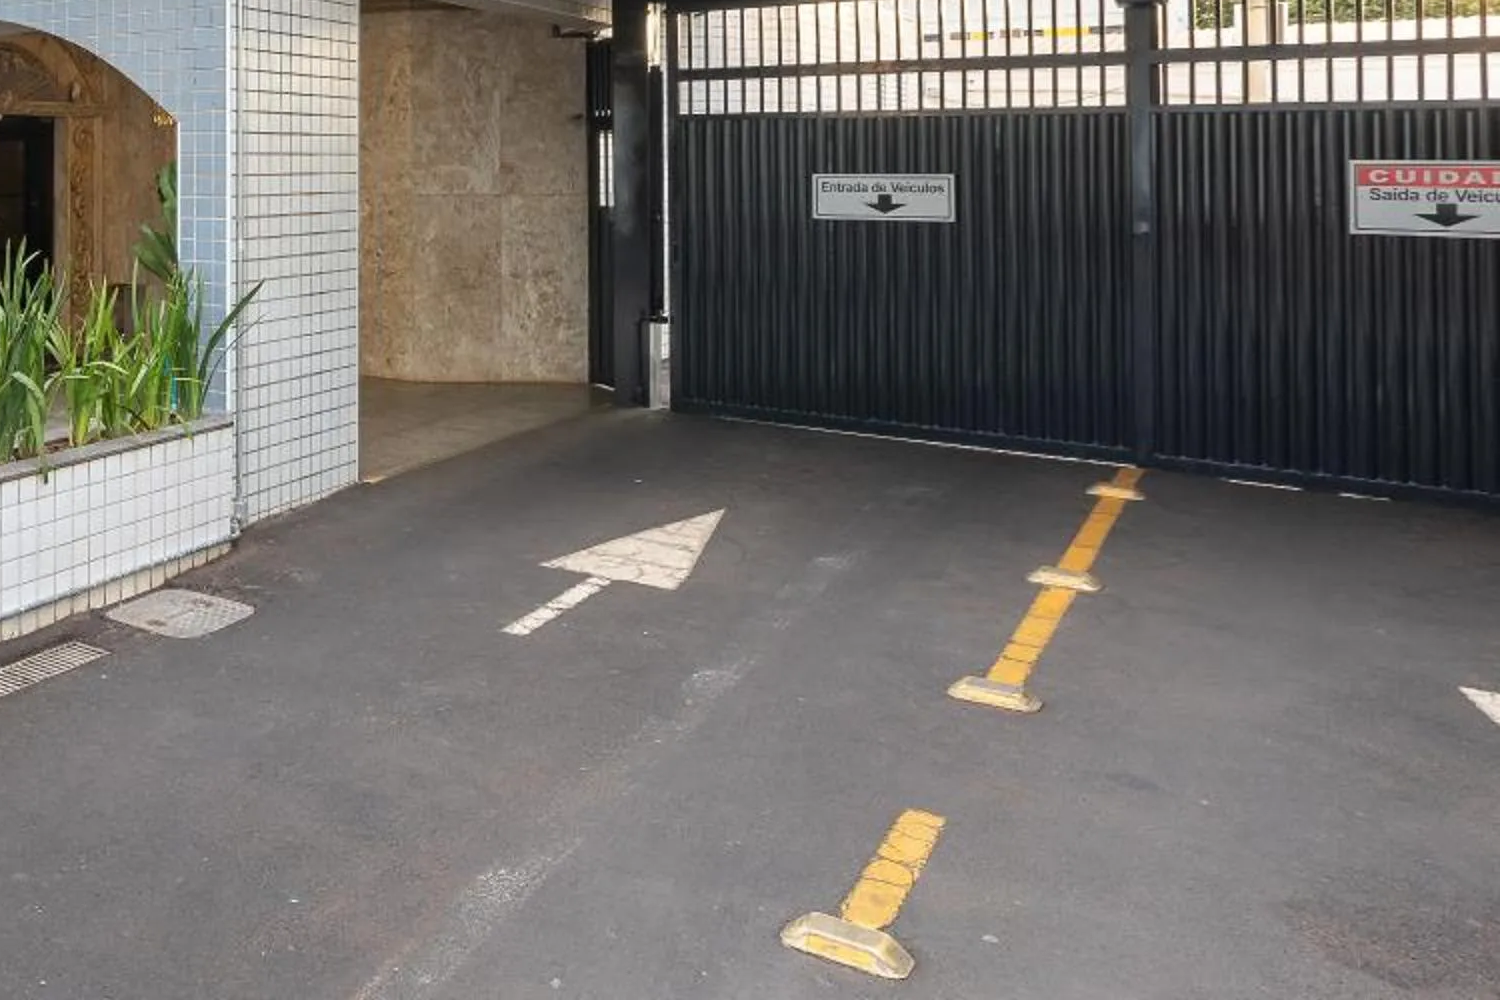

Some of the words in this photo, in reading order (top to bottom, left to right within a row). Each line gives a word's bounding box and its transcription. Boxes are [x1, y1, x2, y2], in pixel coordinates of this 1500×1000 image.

[821, 181, 869, 193] Entrada
[871, 181, 887, 193] de
[1426, 188, 1449, 202] de
